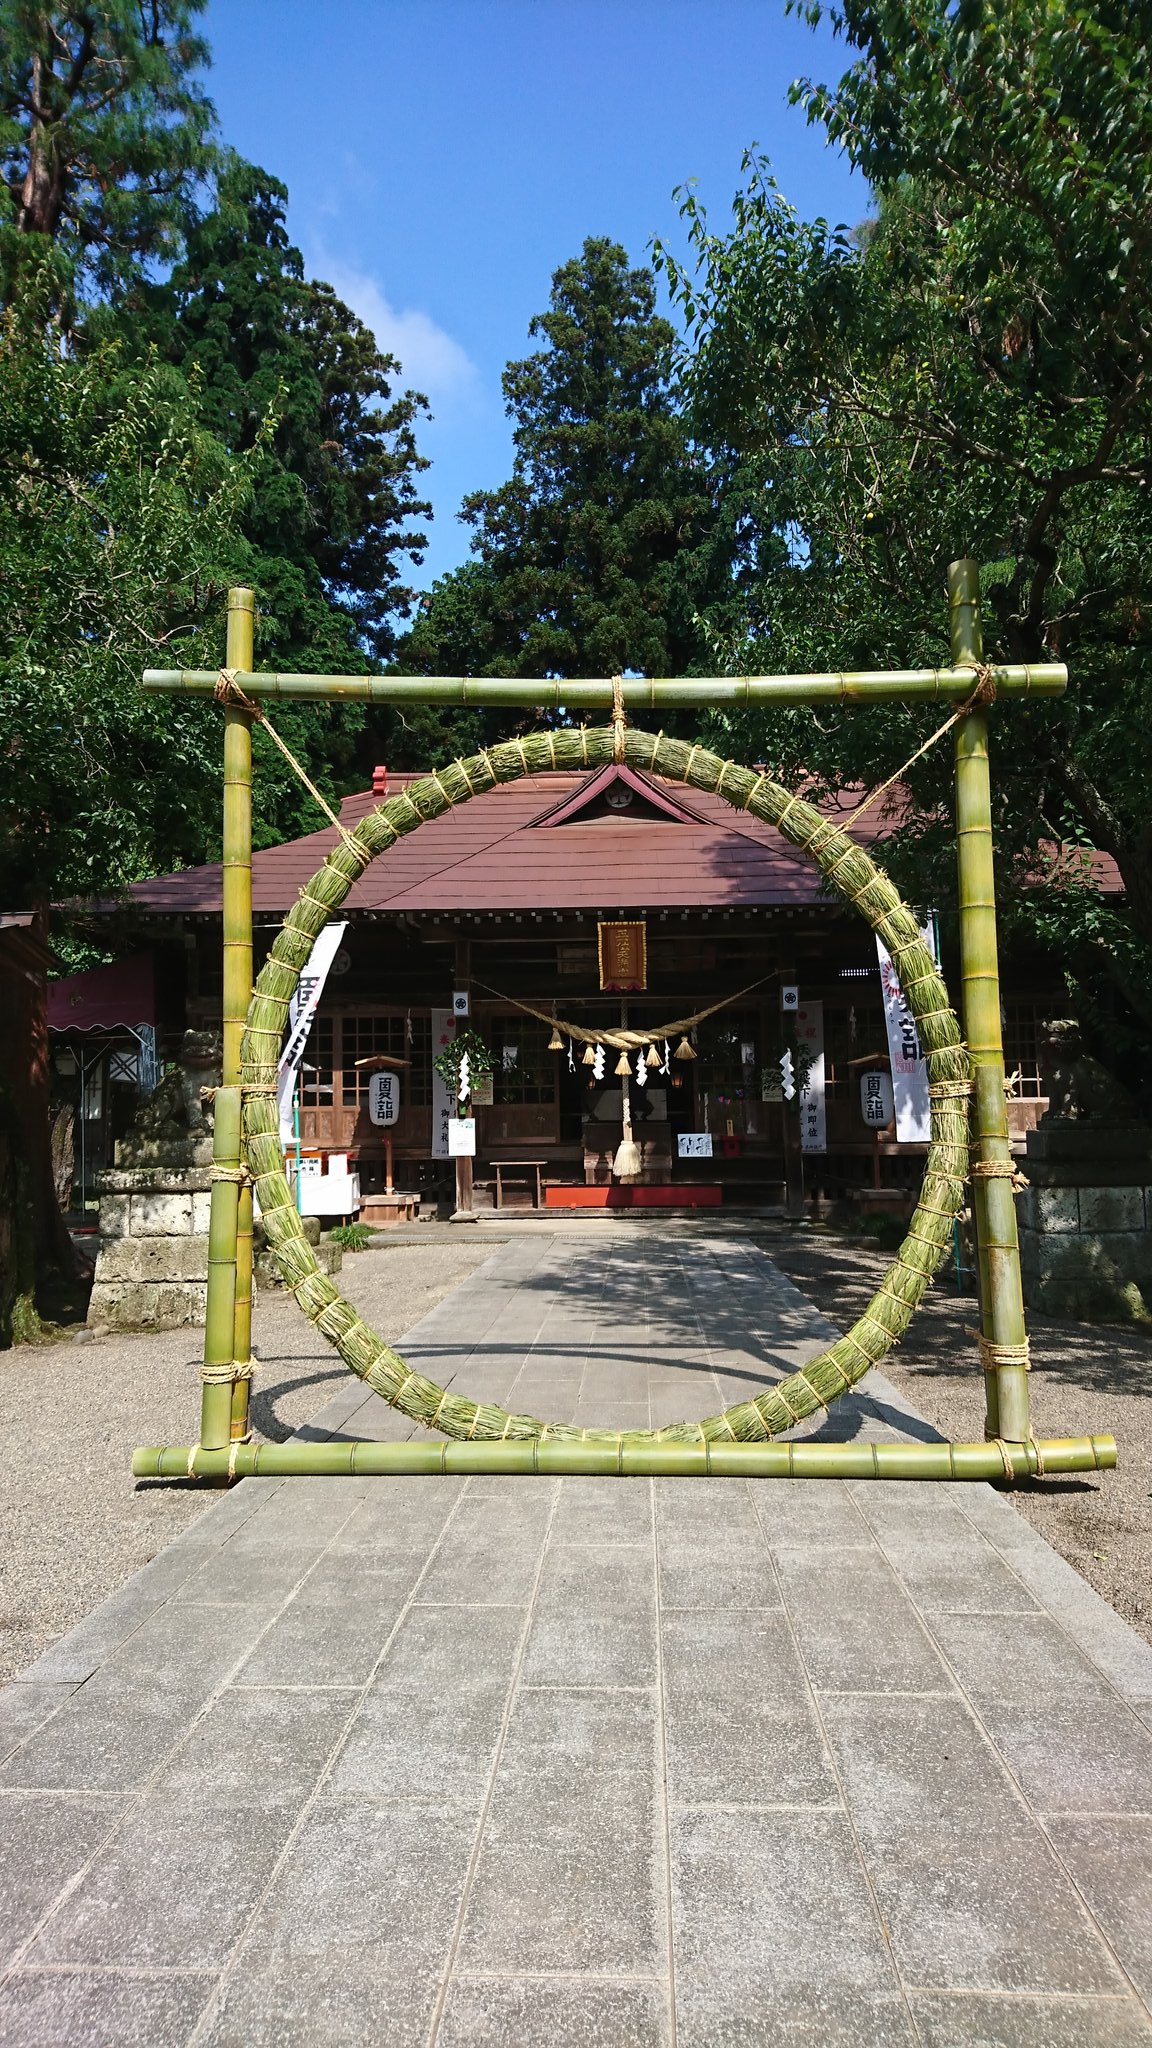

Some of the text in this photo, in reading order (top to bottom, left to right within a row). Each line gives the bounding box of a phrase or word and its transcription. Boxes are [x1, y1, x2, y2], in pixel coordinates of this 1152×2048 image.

[377, 1077, 393, 1120] 夏詣
[866, 1076, 884, 1120] 夏詣
[807, 1103, 818, 1138] 御即位
